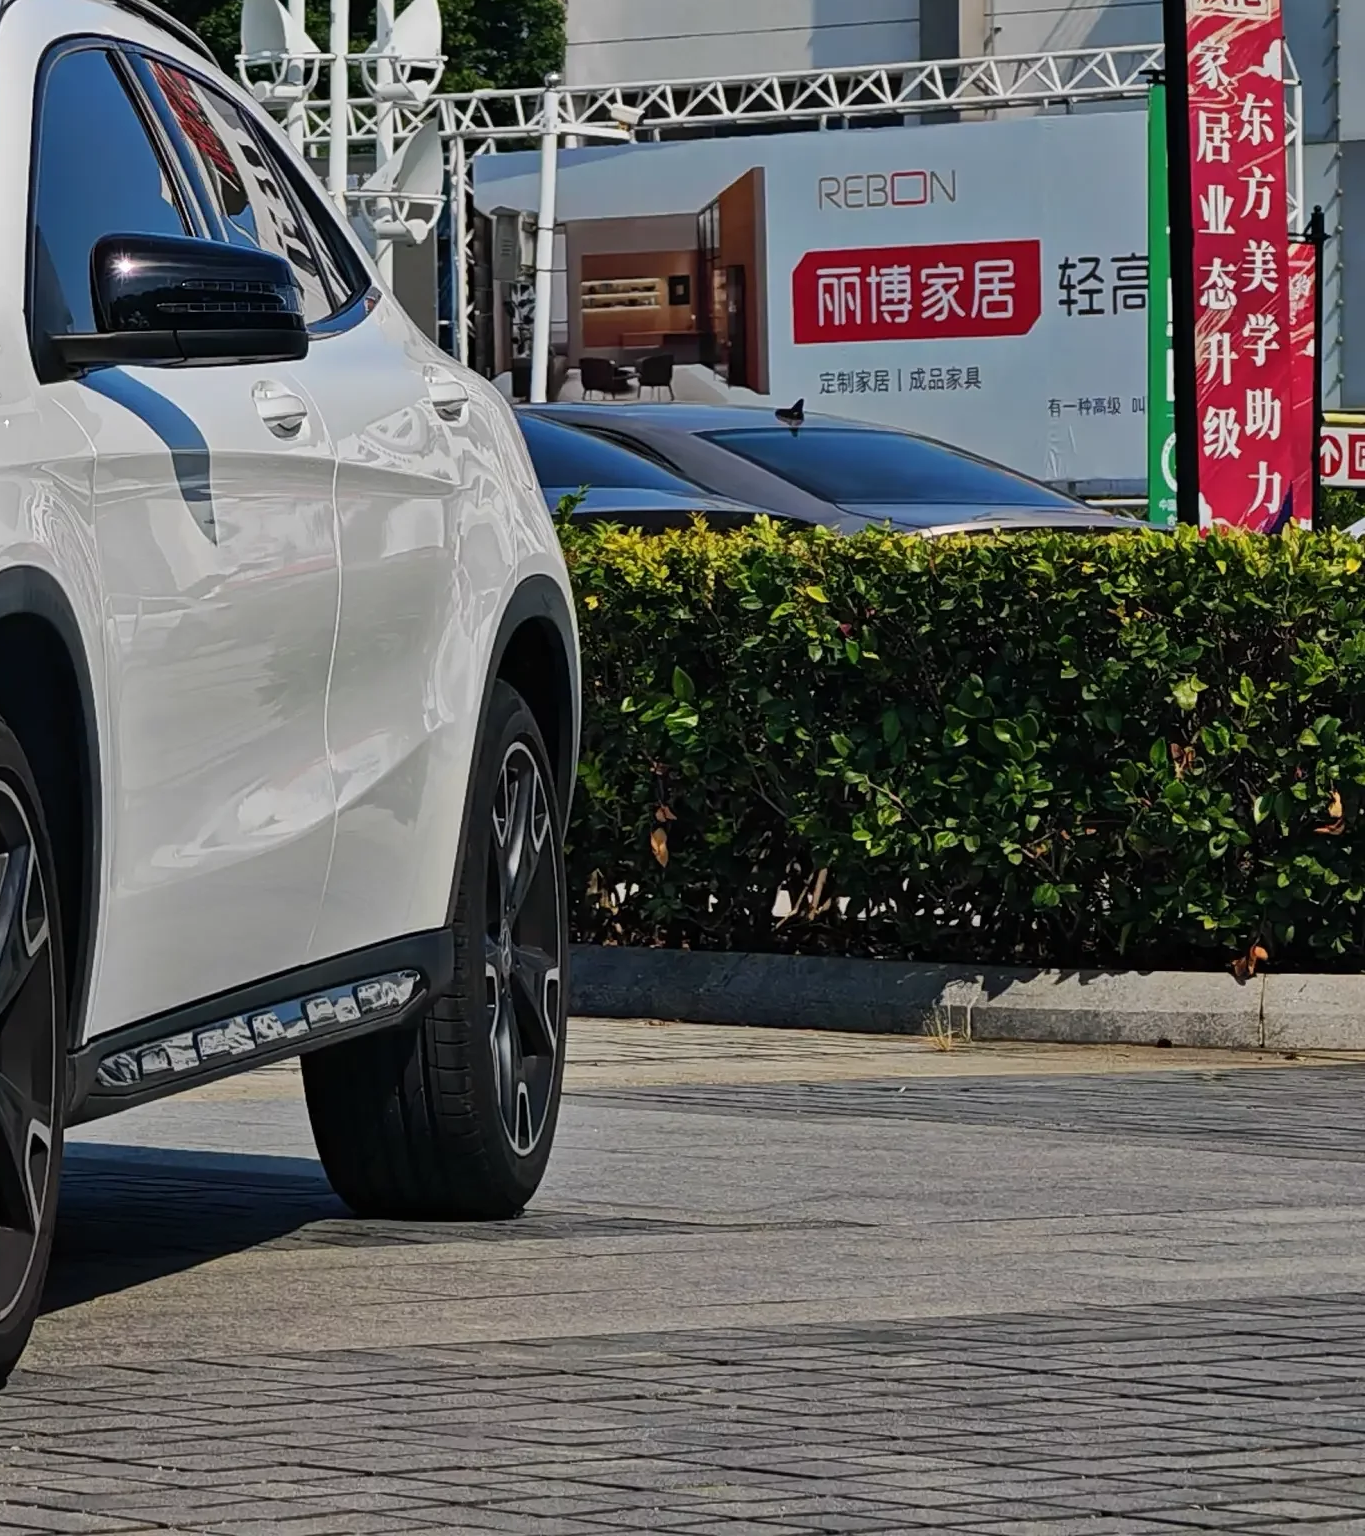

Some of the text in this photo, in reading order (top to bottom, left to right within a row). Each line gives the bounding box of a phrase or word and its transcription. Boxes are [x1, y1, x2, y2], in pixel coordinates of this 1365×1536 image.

[818, 169, 957, 210] REBON
[1195, 40, 1243, 460] 家居业态升级
[816, 252, 1149, 328] 丽博家居 轻高
[1237, 92, 1283, 515] 东方美学助力
[819, 366, 982, 395] 定制家居 成品家具
[1047, 396, 1122, 419] 有一种高级
